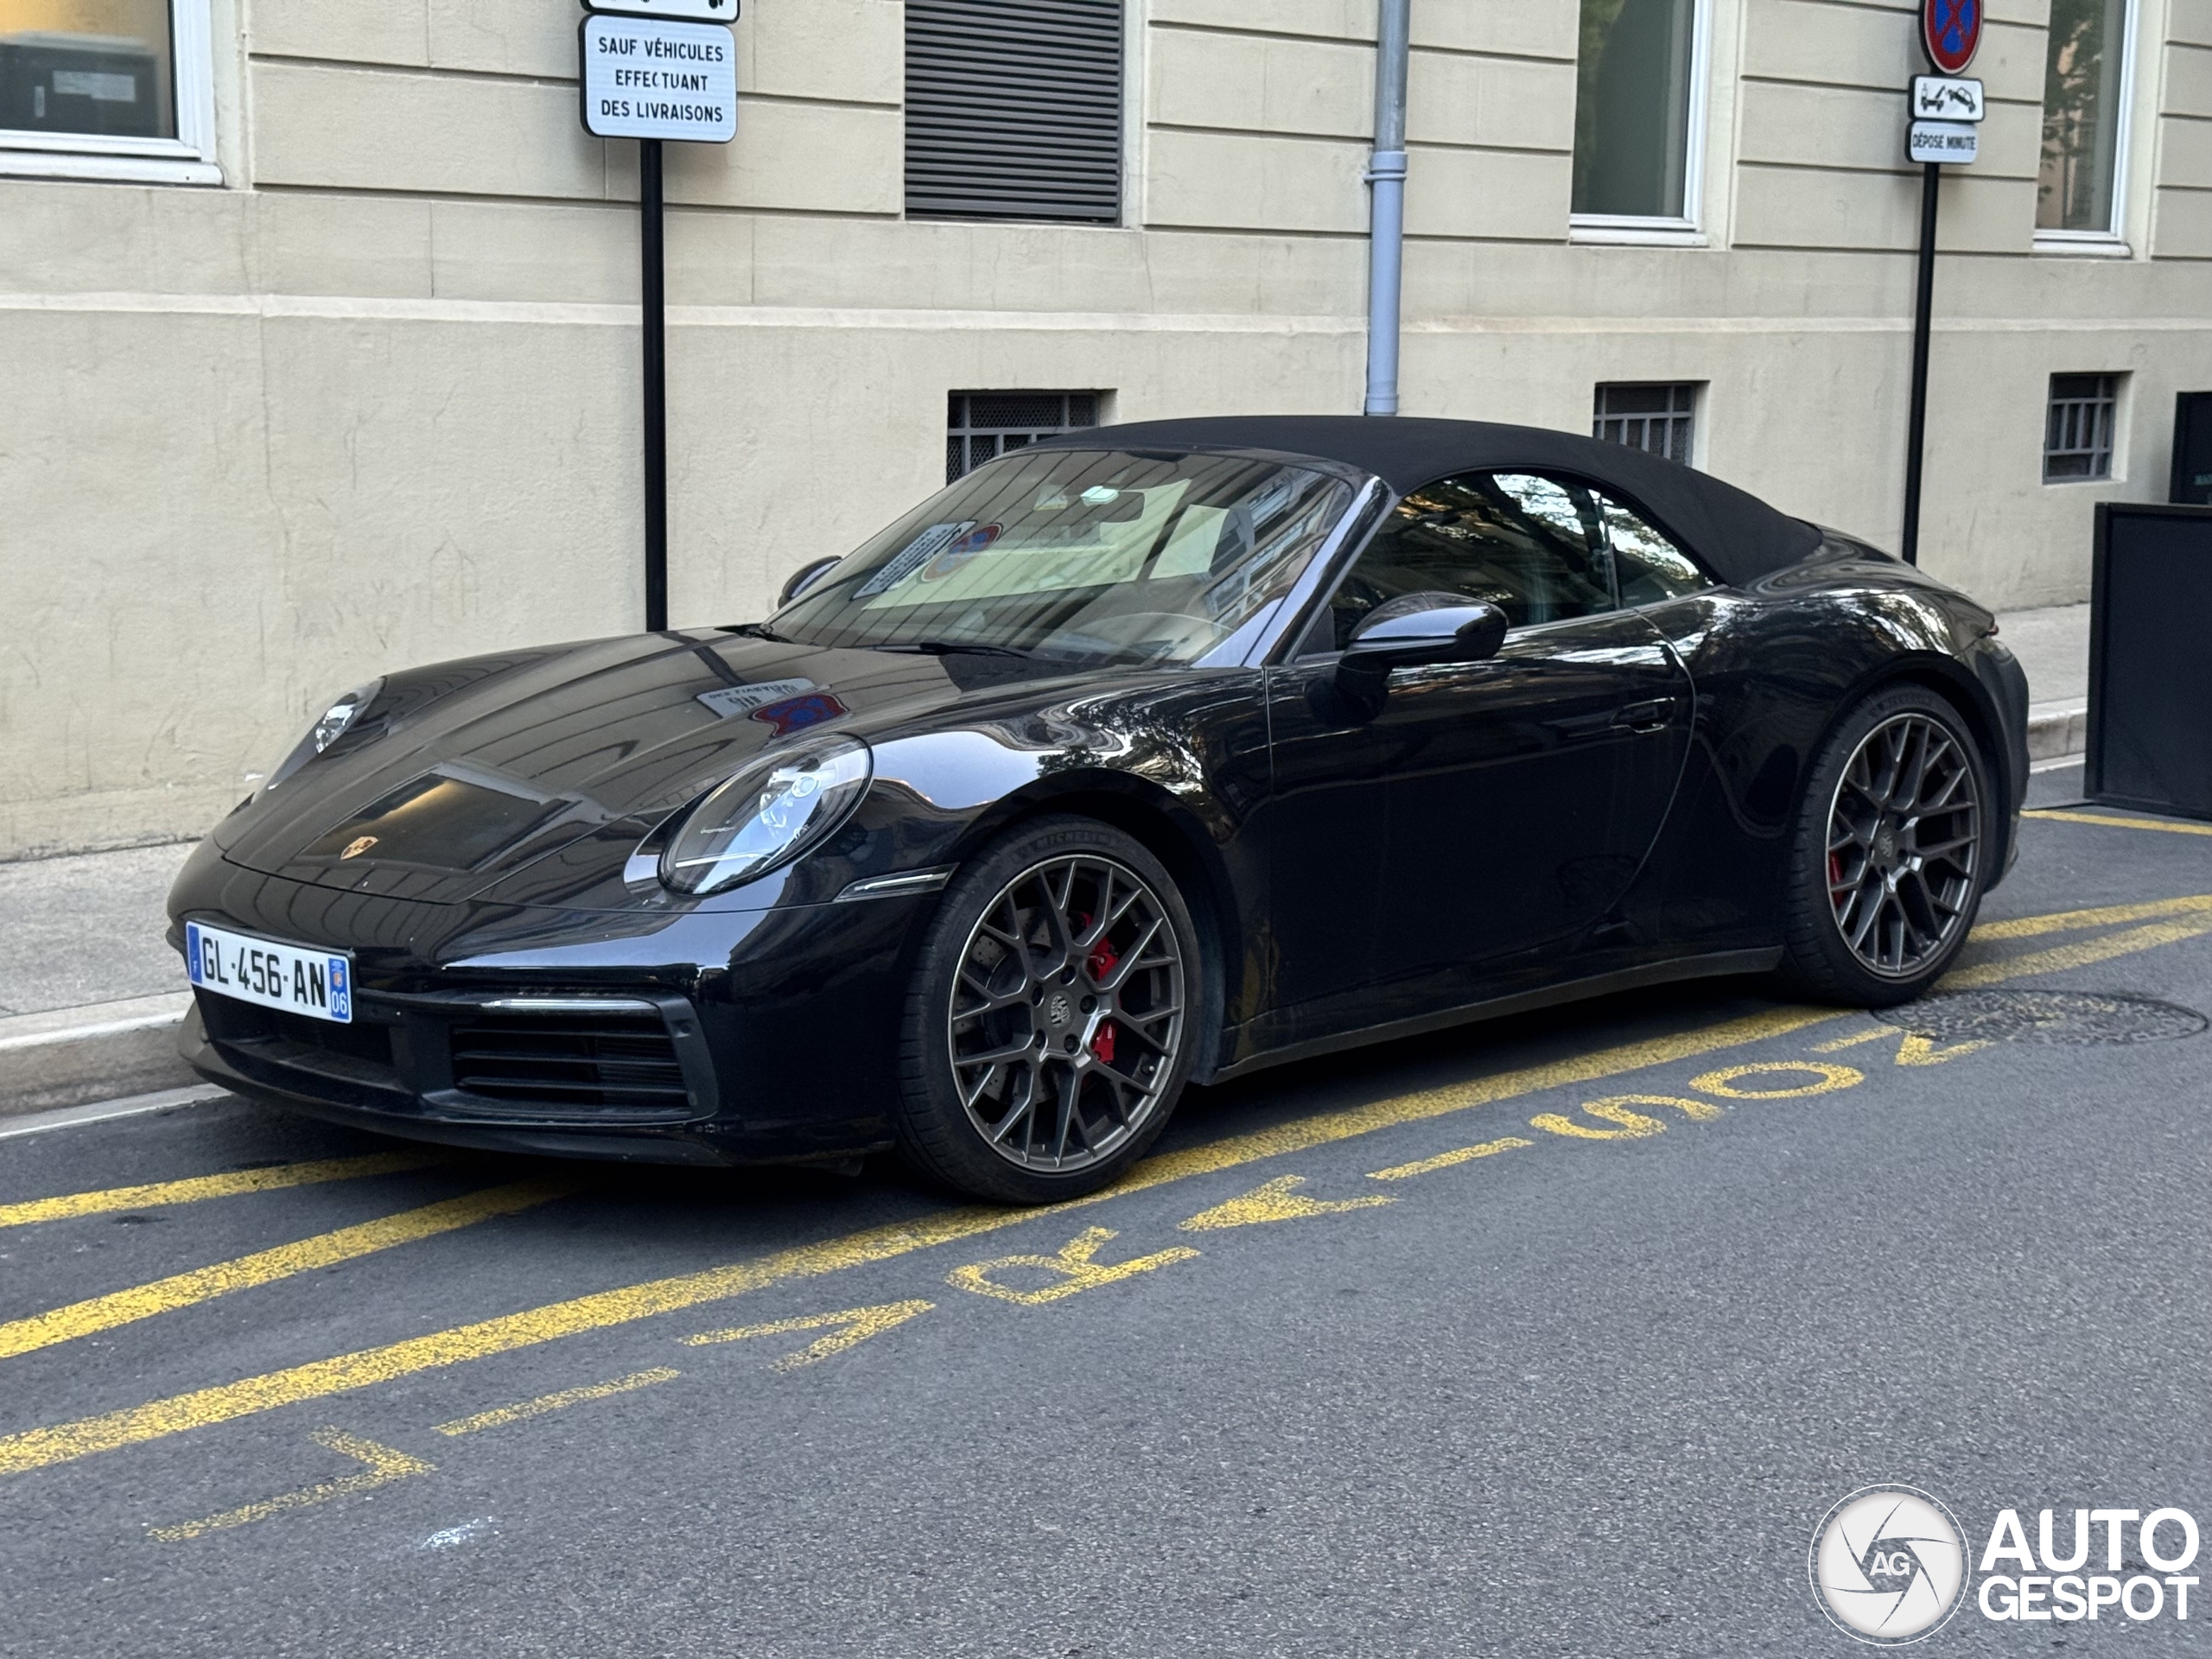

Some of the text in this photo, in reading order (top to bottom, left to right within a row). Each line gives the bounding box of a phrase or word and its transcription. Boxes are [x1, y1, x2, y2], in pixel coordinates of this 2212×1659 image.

[599, 36, 723, 62] SAUF VÉHICULES
[615, 69, 709, 92] EFFECTUANT
[601, 99, 723, 123] DES LIVRAISONS
[1912, 132, 1976, 150] DÉPOSE MINUTE
[331, 990, 347, 1015] 06
